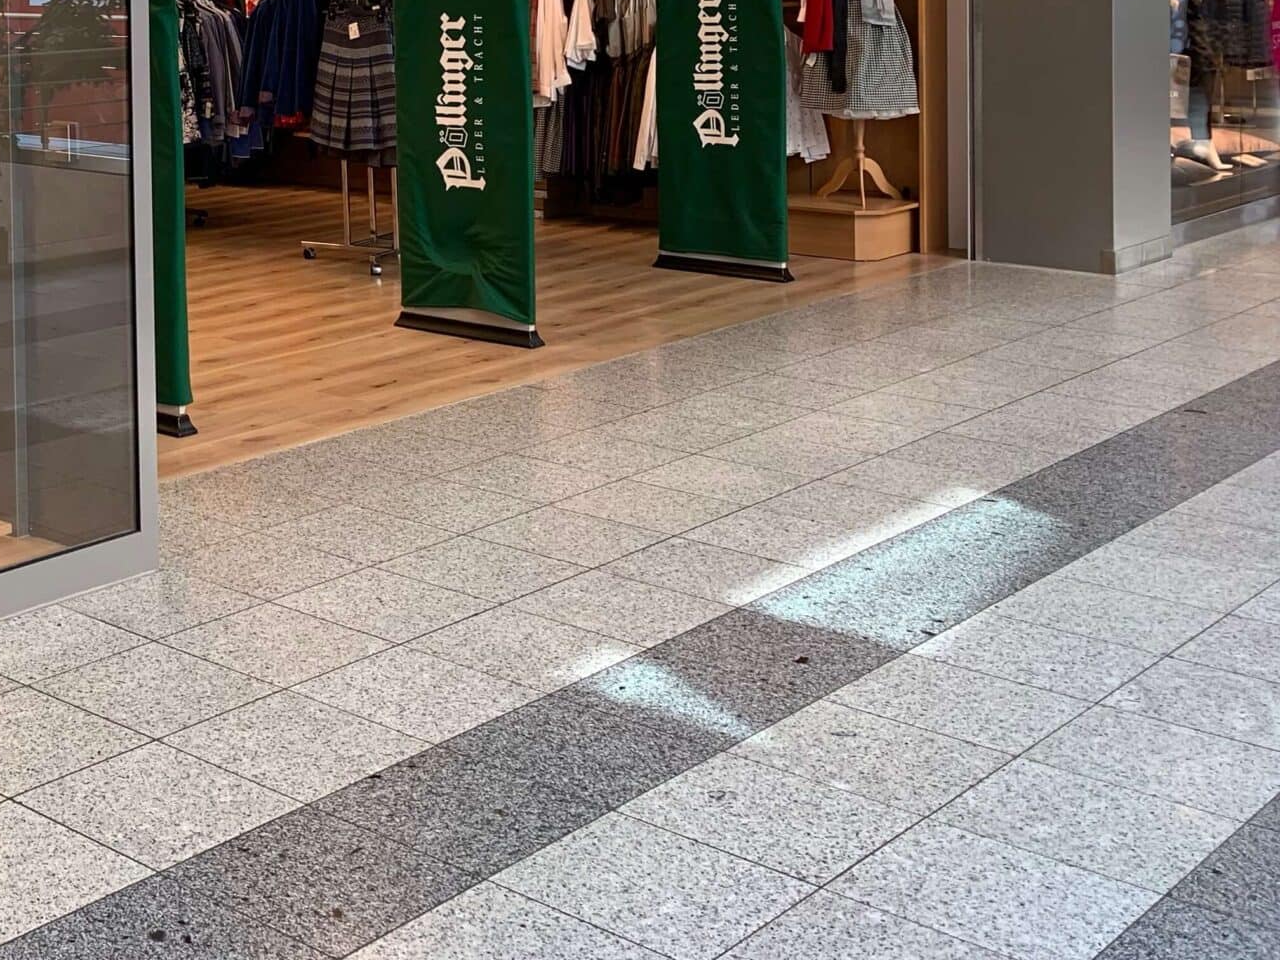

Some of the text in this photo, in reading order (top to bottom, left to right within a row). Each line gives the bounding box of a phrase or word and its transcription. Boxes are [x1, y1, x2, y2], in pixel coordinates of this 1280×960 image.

[474, 14, 484, 83] TRACHT
[435, 12, 486, 191] Pöllinger
[730, 83, 740, 132] LEDER
[474, 118, 486, 173] LEDER
